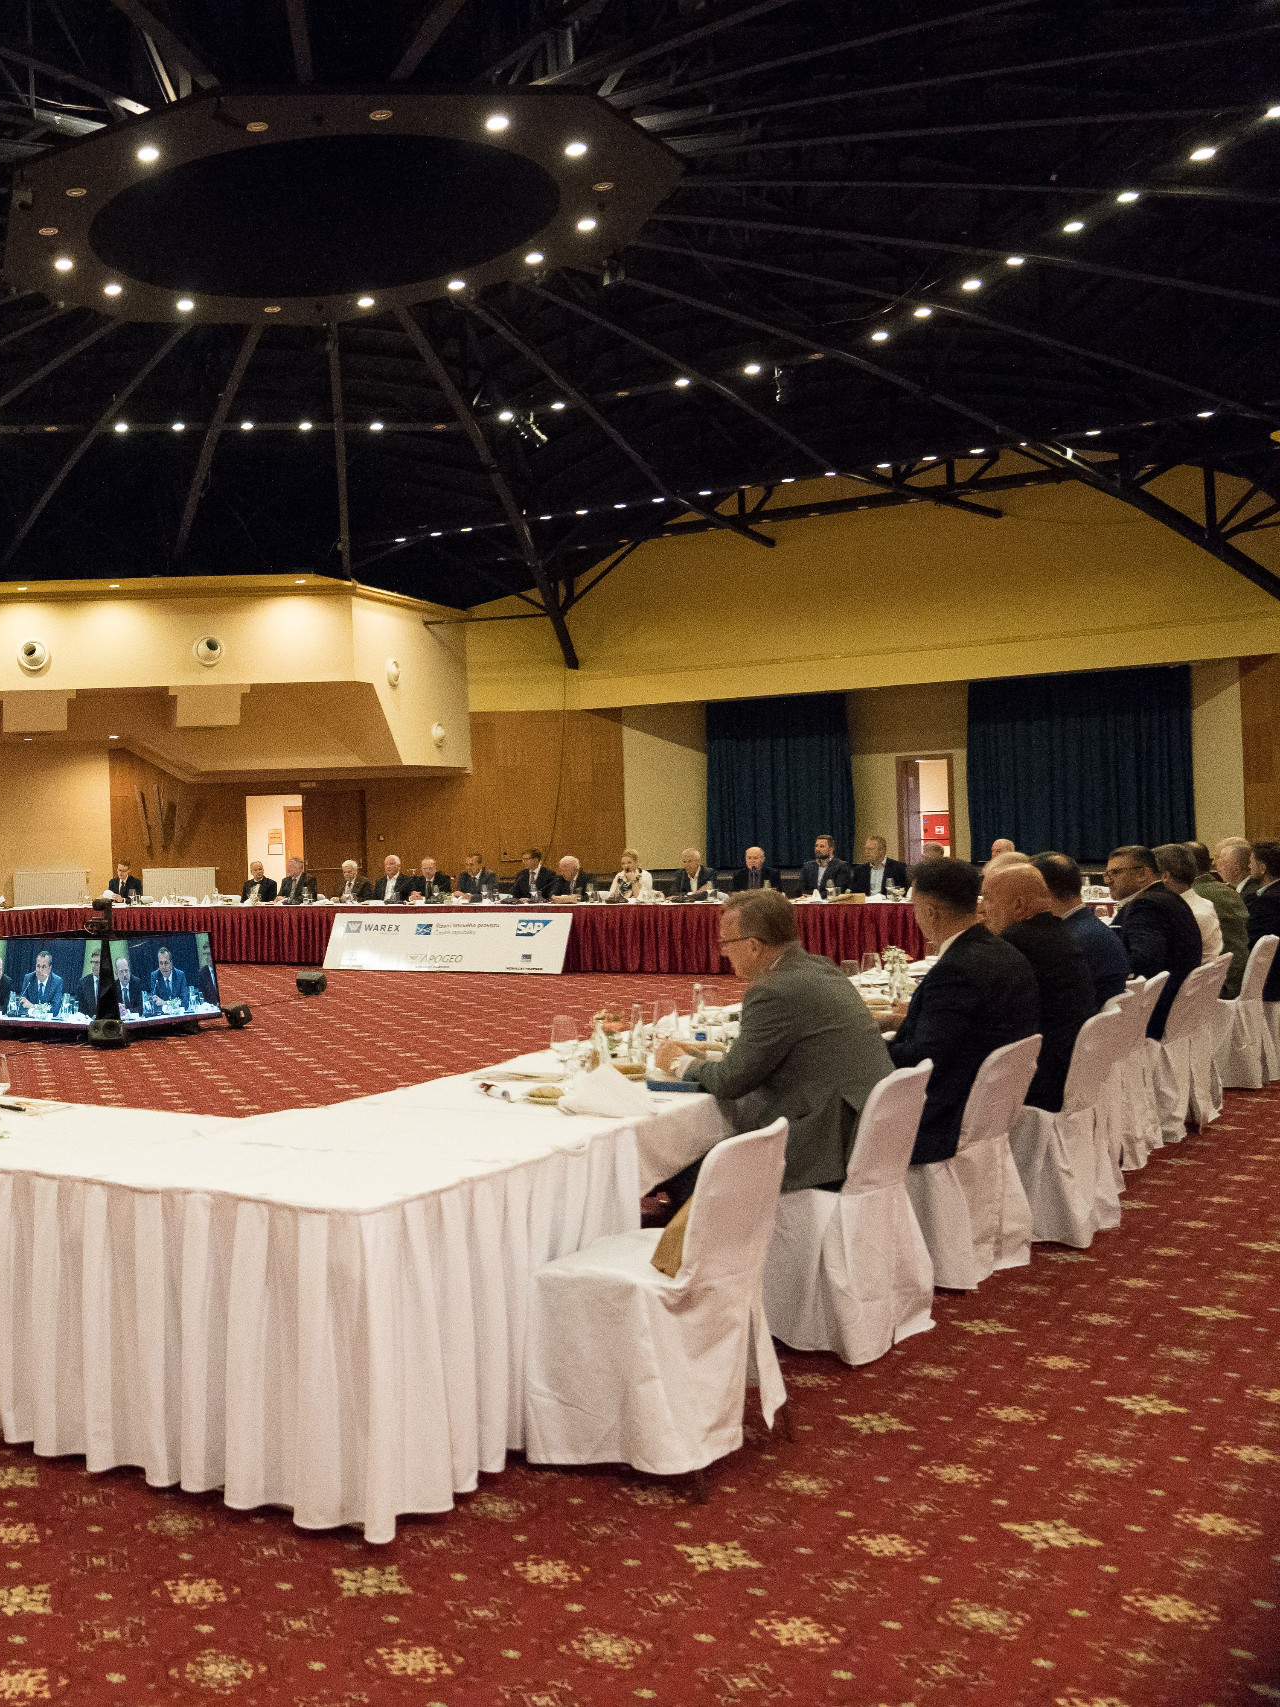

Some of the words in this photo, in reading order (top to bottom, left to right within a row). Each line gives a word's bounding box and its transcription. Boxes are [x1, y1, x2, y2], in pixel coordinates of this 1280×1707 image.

[365, 923, 401, 932] WAREX
[516, 922, 544, 933] SAP
[420, 954, 463, 963] APOGEO
